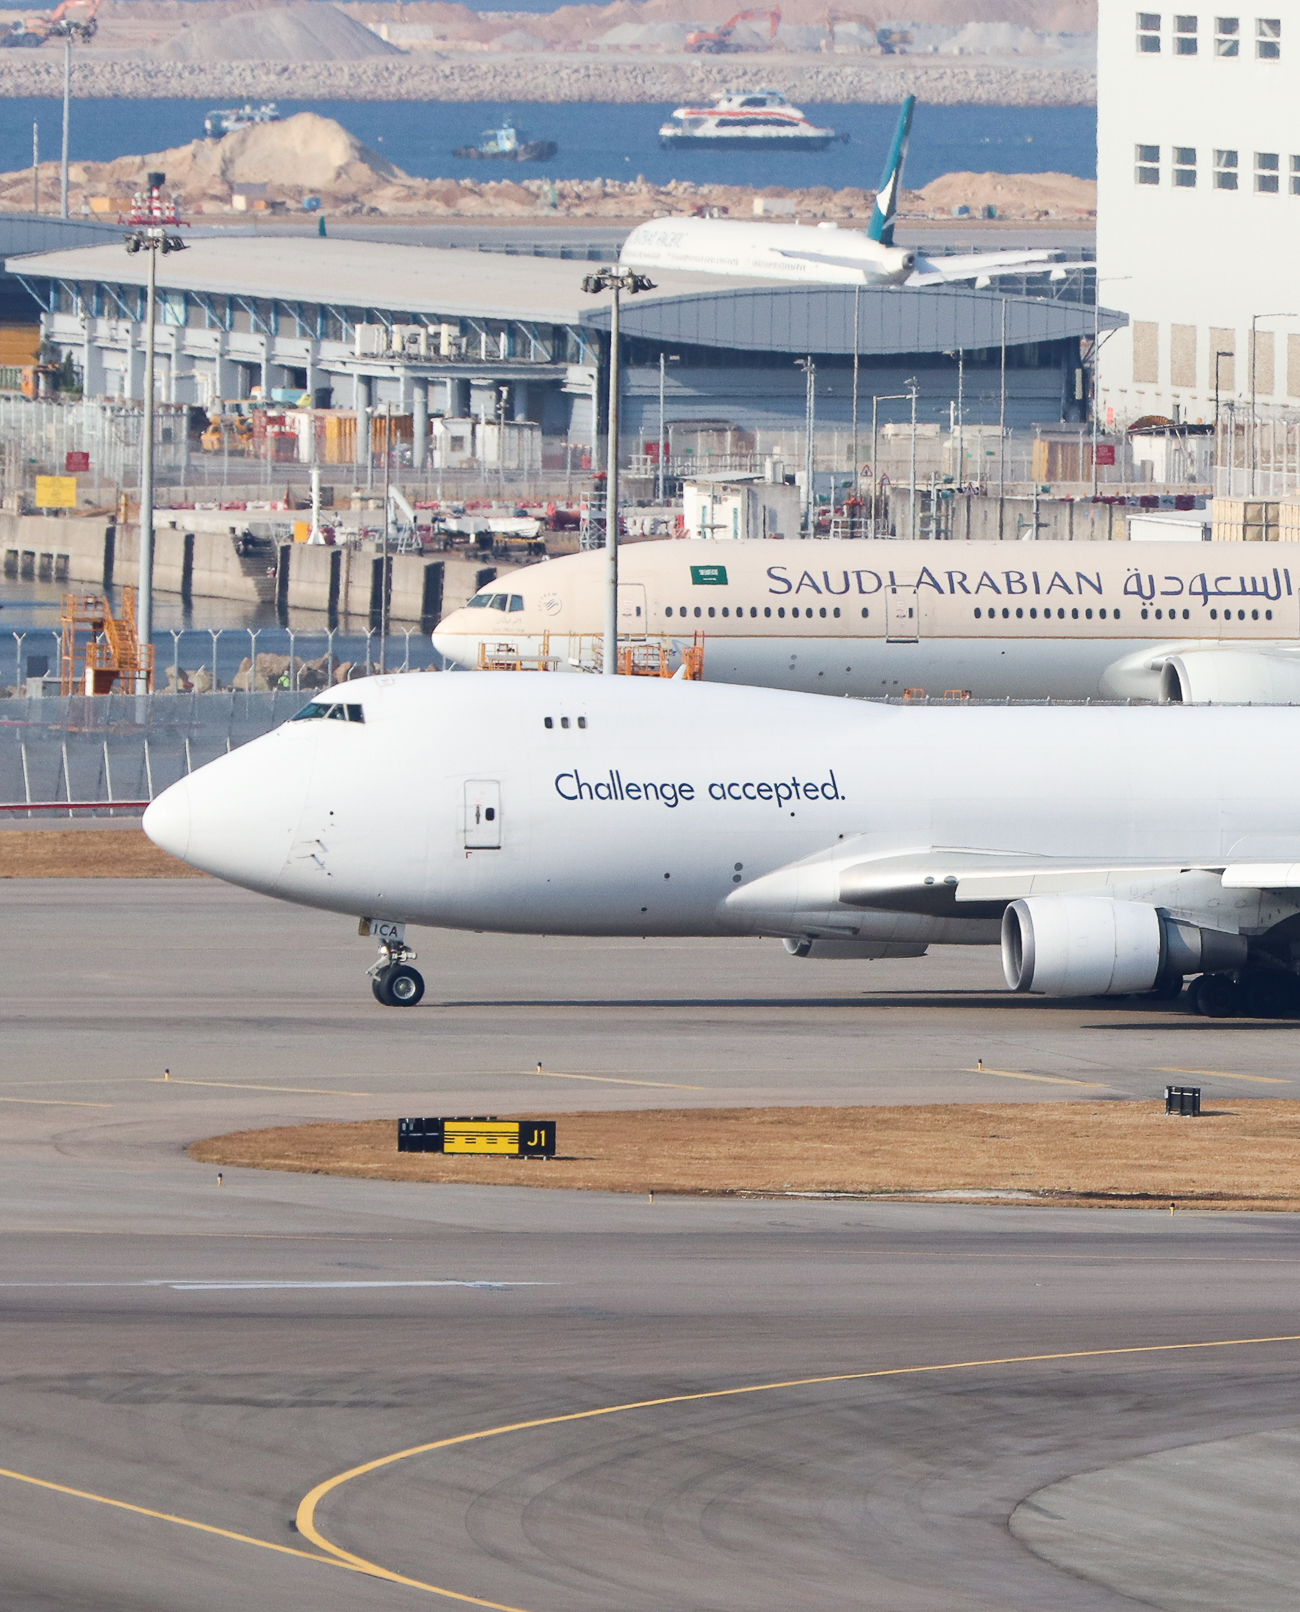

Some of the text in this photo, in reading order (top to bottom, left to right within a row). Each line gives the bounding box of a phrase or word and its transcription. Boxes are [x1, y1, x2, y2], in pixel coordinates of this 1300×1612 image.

[766, 565, 1103, 595] SAUDI ARABIAN
[1123, 567, 1293, 607] السعودية
[555, 769, 846, 808] Challenge accepted.
[373, 923, 398, 938] ICA
[527, 1129, 546, 1147] J1
